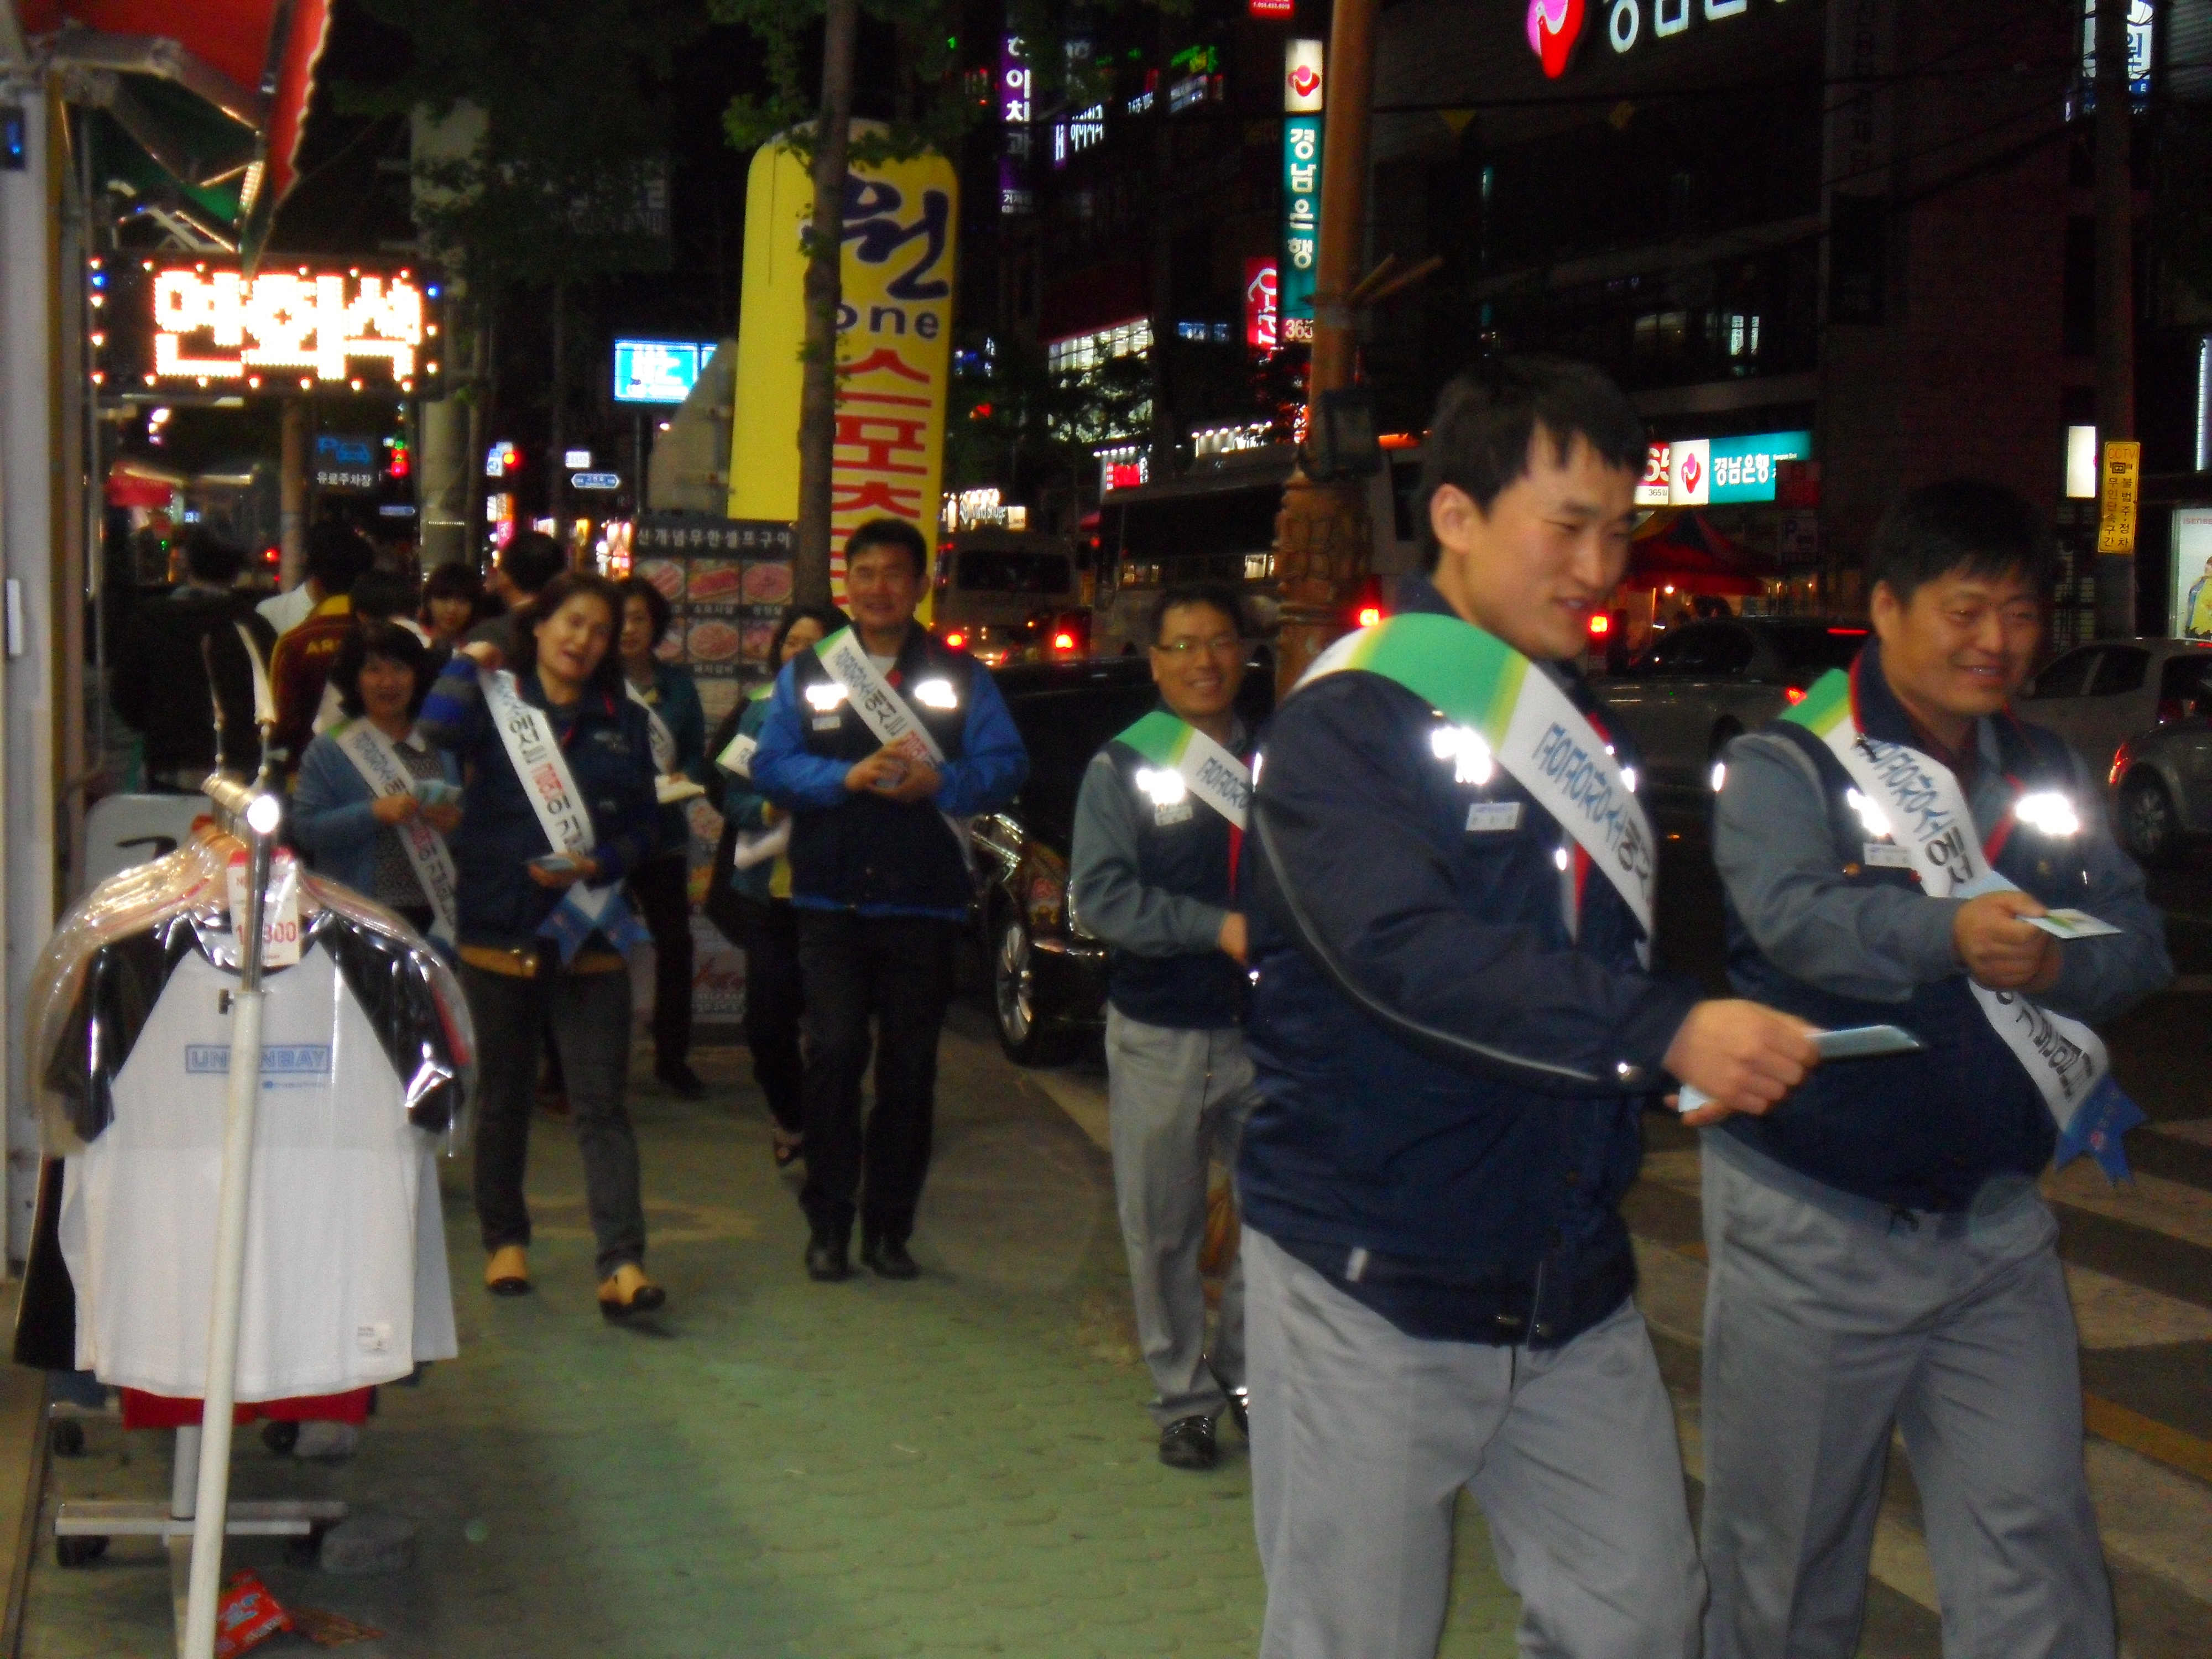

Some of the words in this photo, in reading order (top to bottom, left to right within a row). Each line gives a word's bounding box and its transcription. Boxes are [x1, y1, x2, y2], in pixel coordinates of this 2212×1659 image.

[1290, 128, 1316, 269] 경남은행
[1285, 319, 1314, 339] 365
[2107, 447, 2137, 460] CCTV
[1714, 453, 1770, 487] 경남은행
[191, 1050, 326, 1068] UNNBAY
